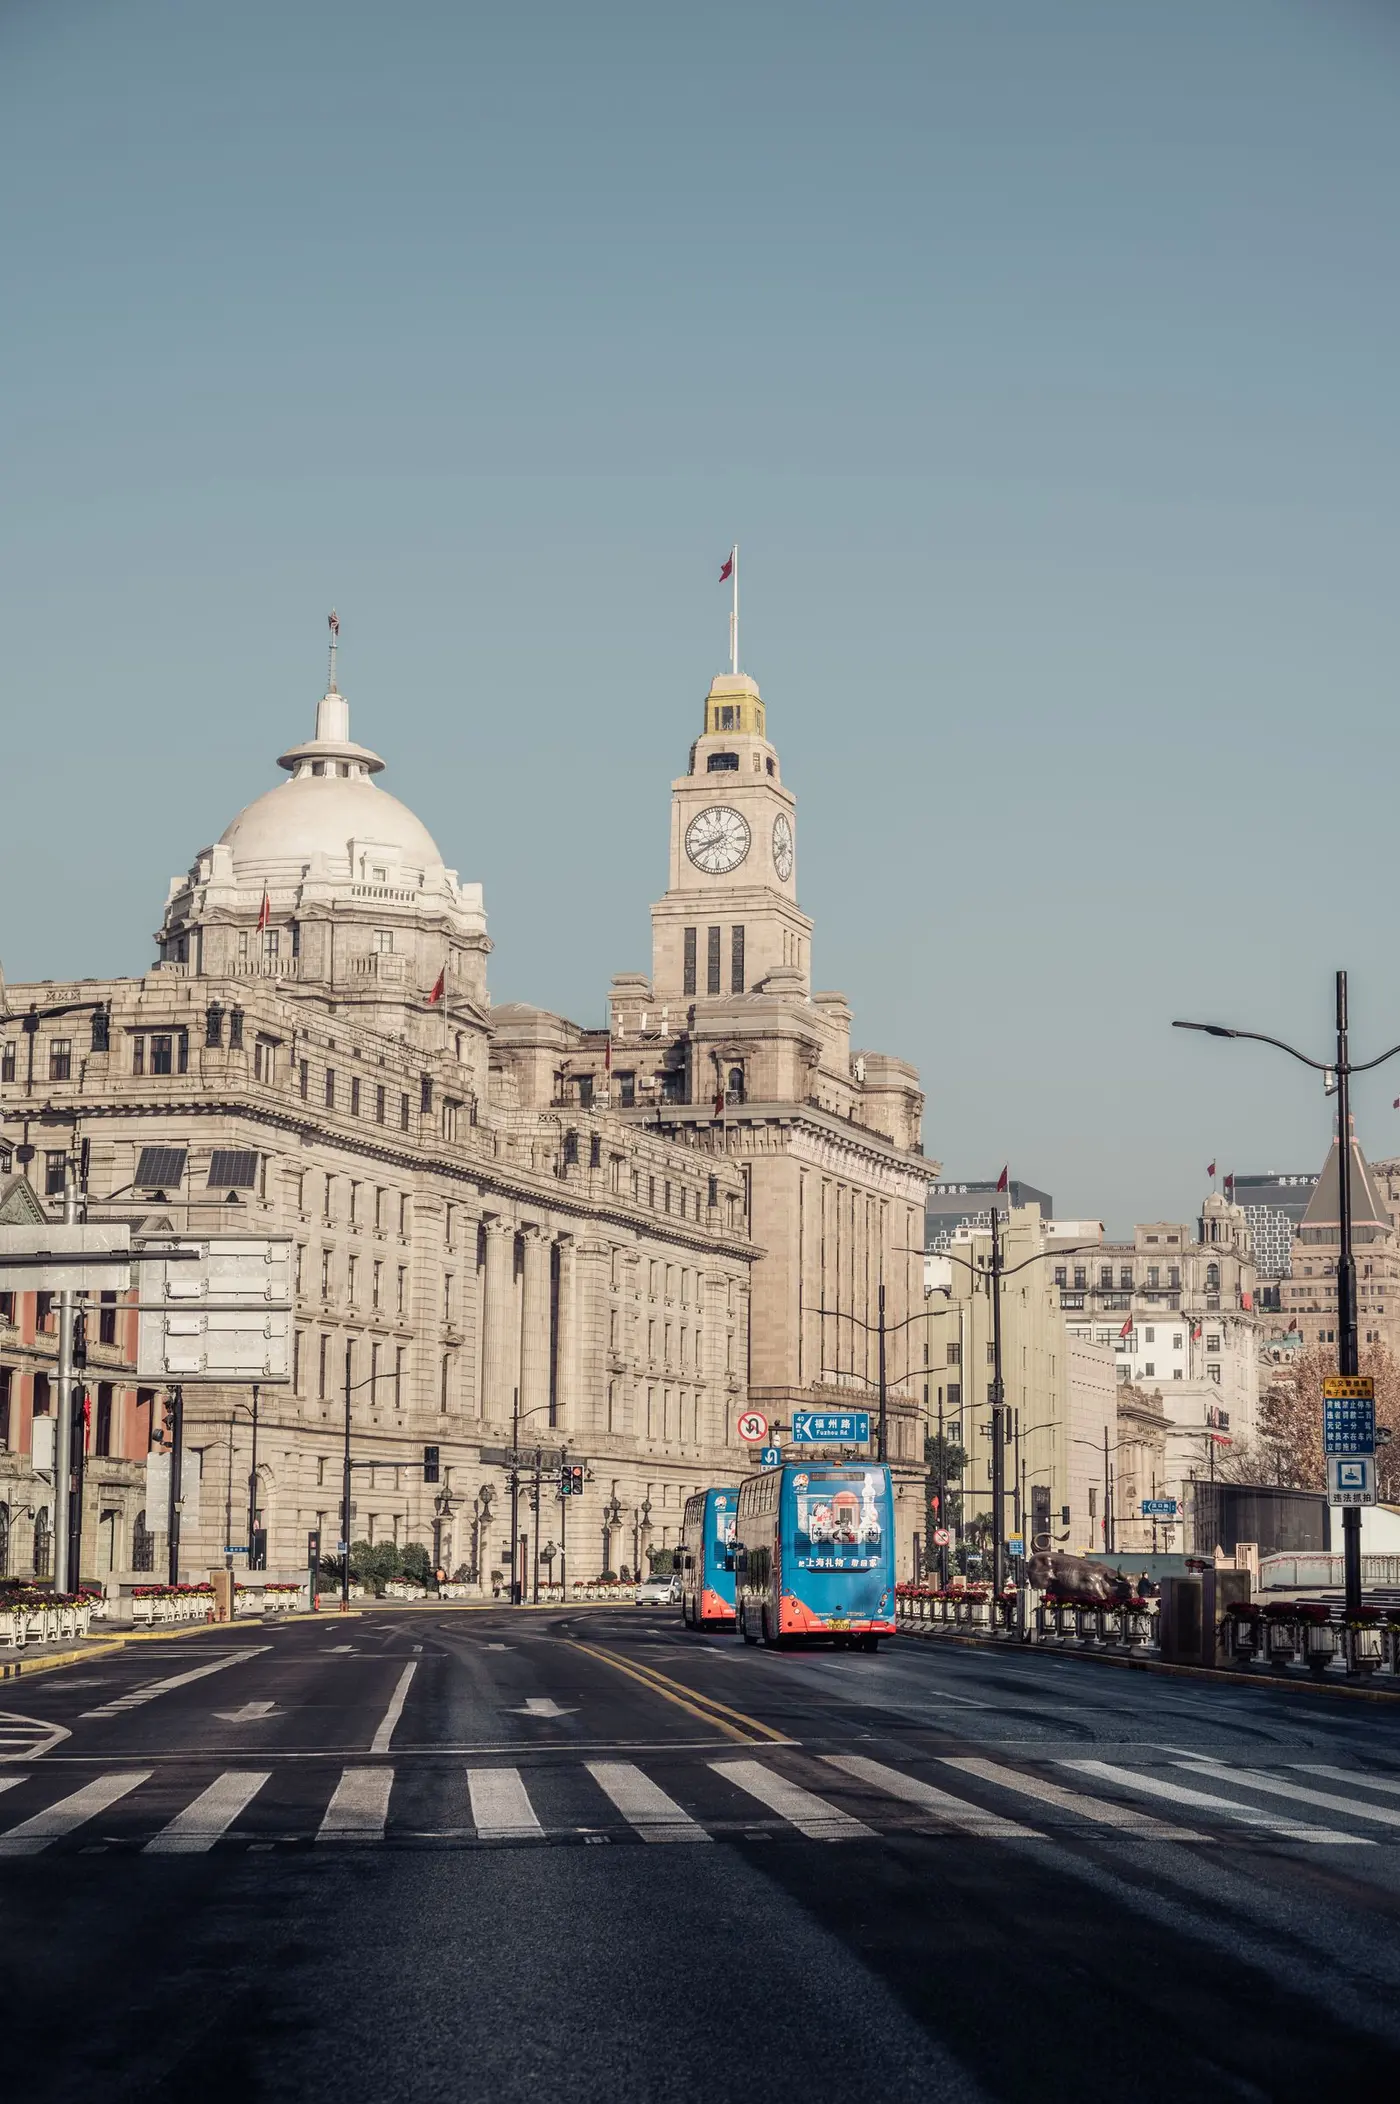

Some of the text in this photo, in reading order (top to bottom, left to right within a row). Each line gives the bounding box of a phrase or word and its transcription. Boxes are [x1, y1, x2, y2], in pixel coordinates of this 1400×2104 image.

[1326, 1400, 1372, 1410] 黄线禁止停车
[1326, 1410, 1372, 1420] 违者罚款二百
[815, 1418, 850, 1428] 福州路
[1326, 1431, 1373, 1441] 驶员不在车内
[1333, 1492, 1372, 1503] 违法抓拍
